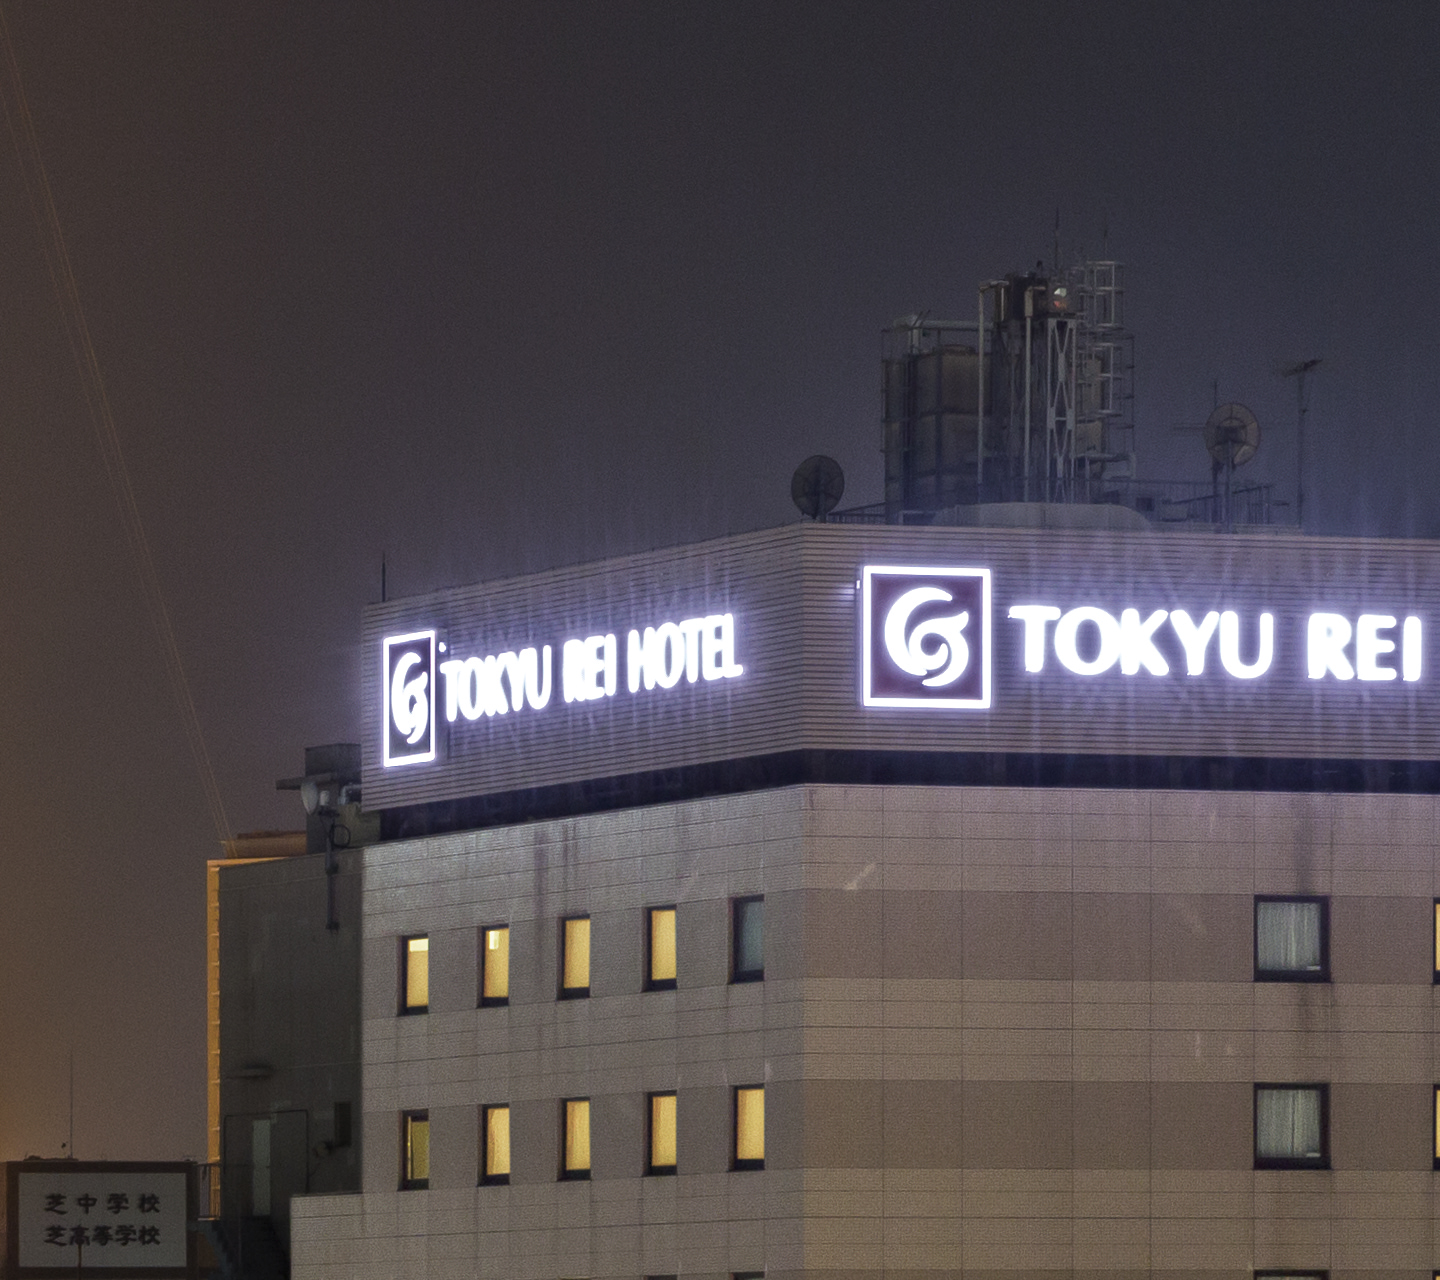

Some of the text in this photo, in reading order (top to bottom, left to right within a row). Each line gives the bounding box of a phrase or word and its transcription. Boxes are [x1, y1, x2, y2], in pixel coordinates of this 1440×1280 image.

[439, 613, 744, 723] TOKYU REI HOTEL
[1008, 605, 1275, 679] TOKYU
[1307, 612, 1423, 682] REI
[44, 1192, 161, 1215] 芝中学校
[44, 1224, 161, 1247] 芝高等学校
